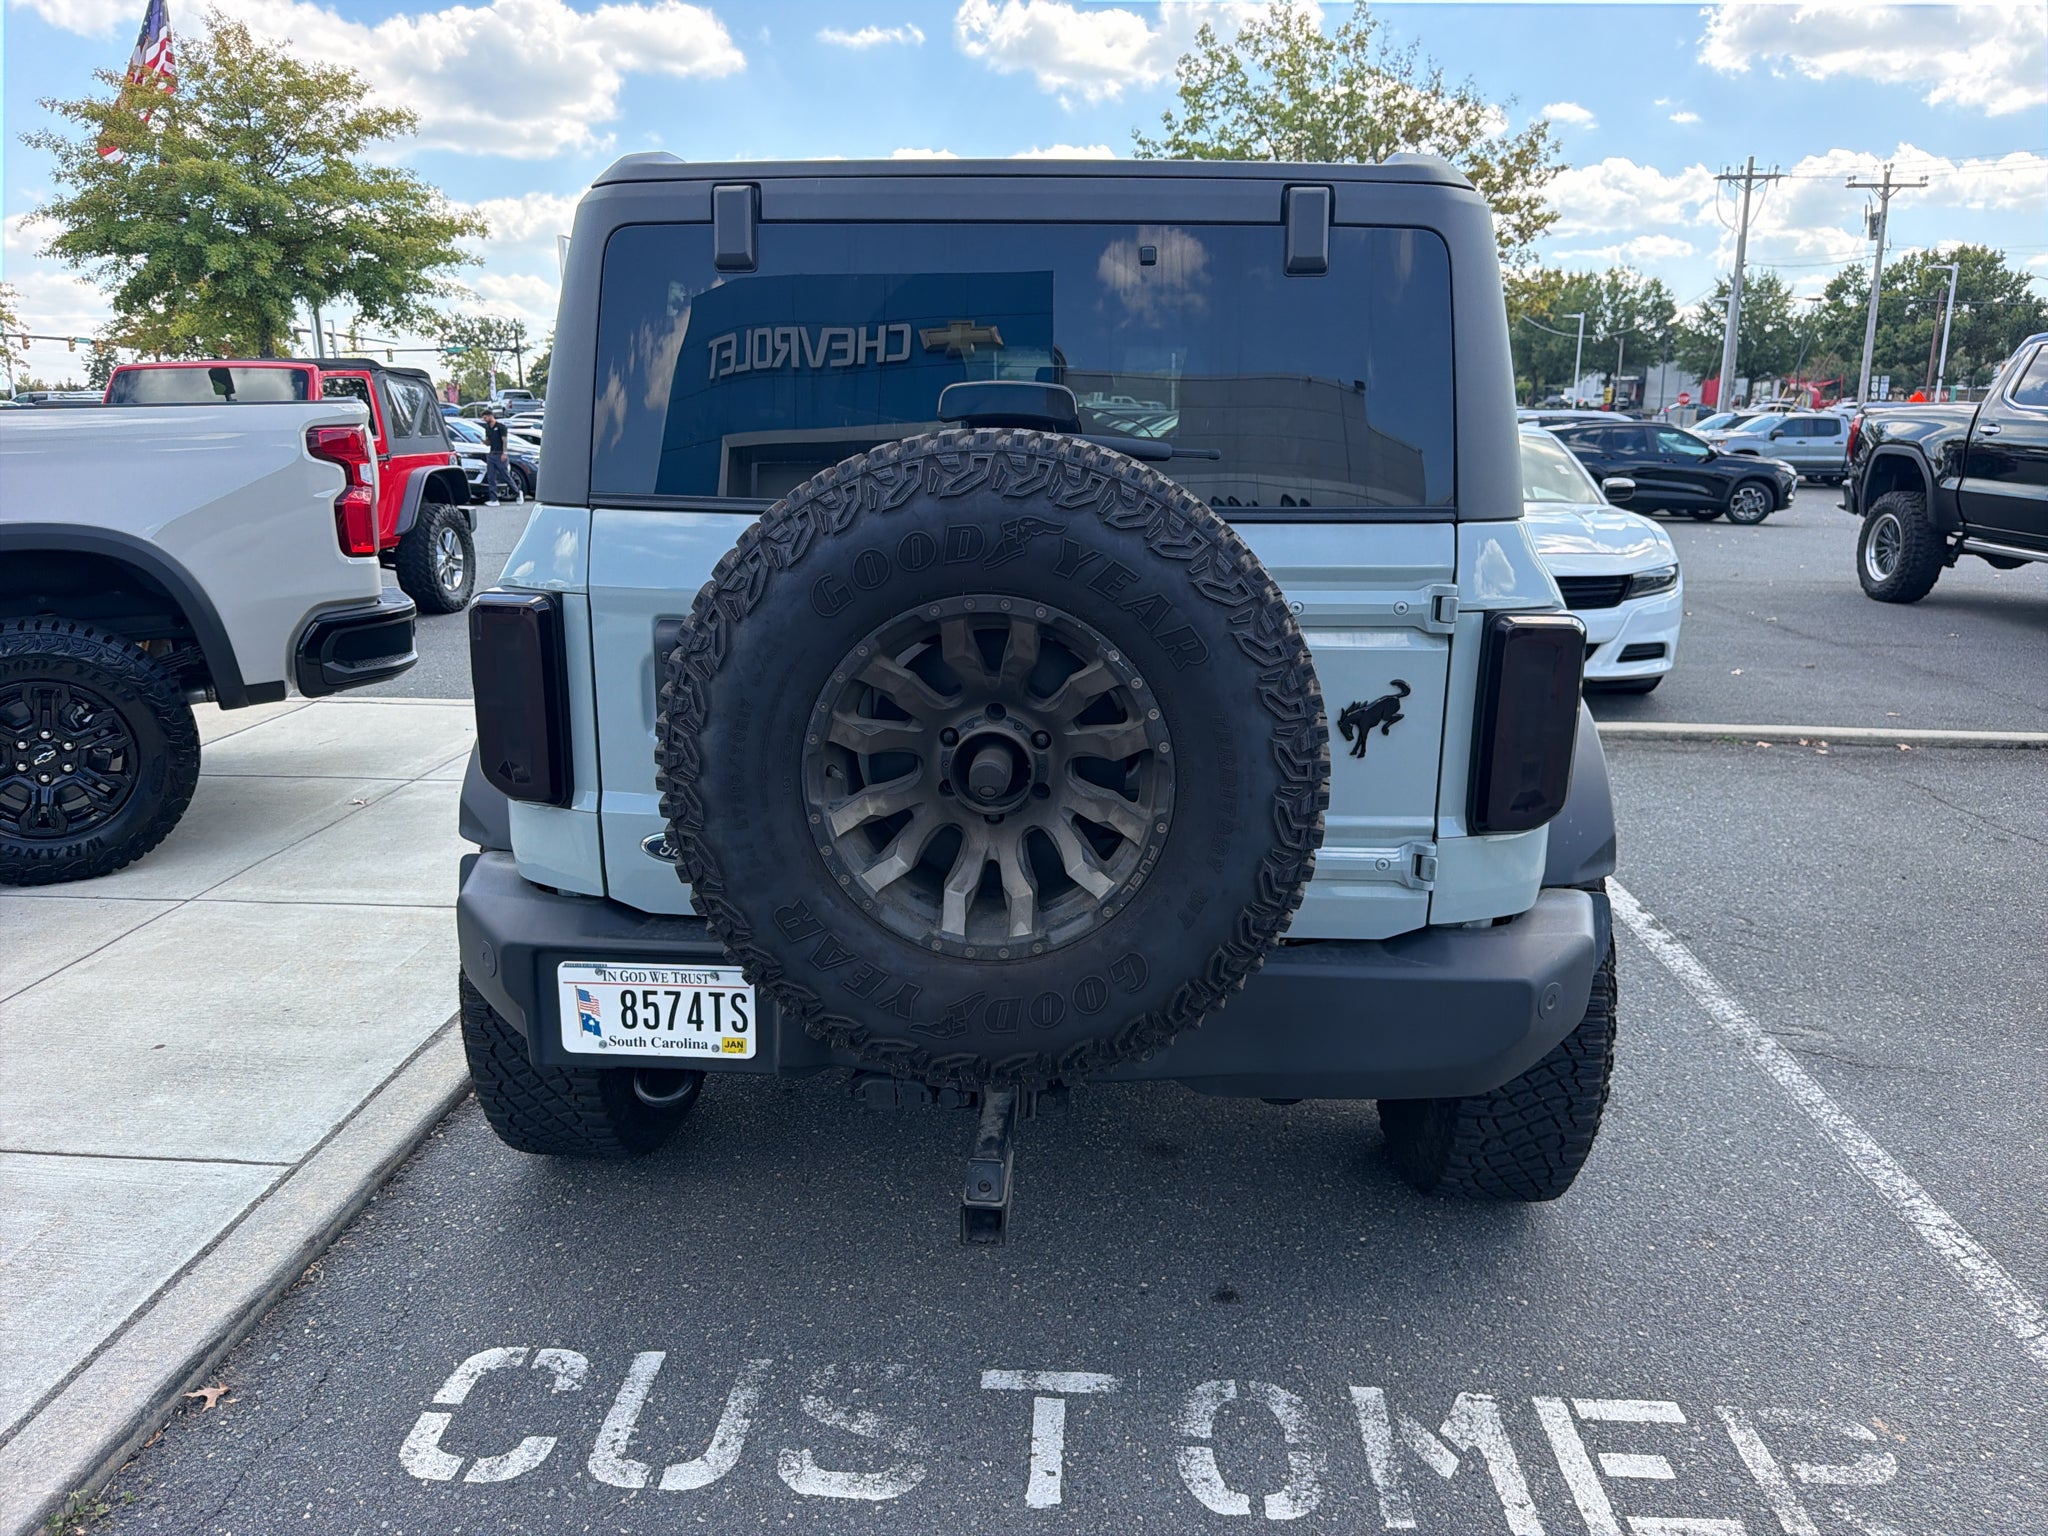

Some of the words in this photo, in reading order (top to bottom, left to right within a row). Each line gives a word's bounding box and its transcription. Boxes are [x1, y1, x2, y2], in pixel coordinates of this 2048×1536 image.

[1120, 844, 1159, 895] FUEL
[603, 969, 617, 982] IN
[620, 970, 648, 982] GOD
[650, 971, 668, 983] WE
[671, 971, 710, 984] TRUST
[620, 989, 749, 1033] 8574TS
[608, 1034, 647, 1048] South
[651, 1036, 709, 1050] Carolina
[724, 1040, 744, 1049] JAN
[399, 1346, 1898, 1536] CUSTOMER
